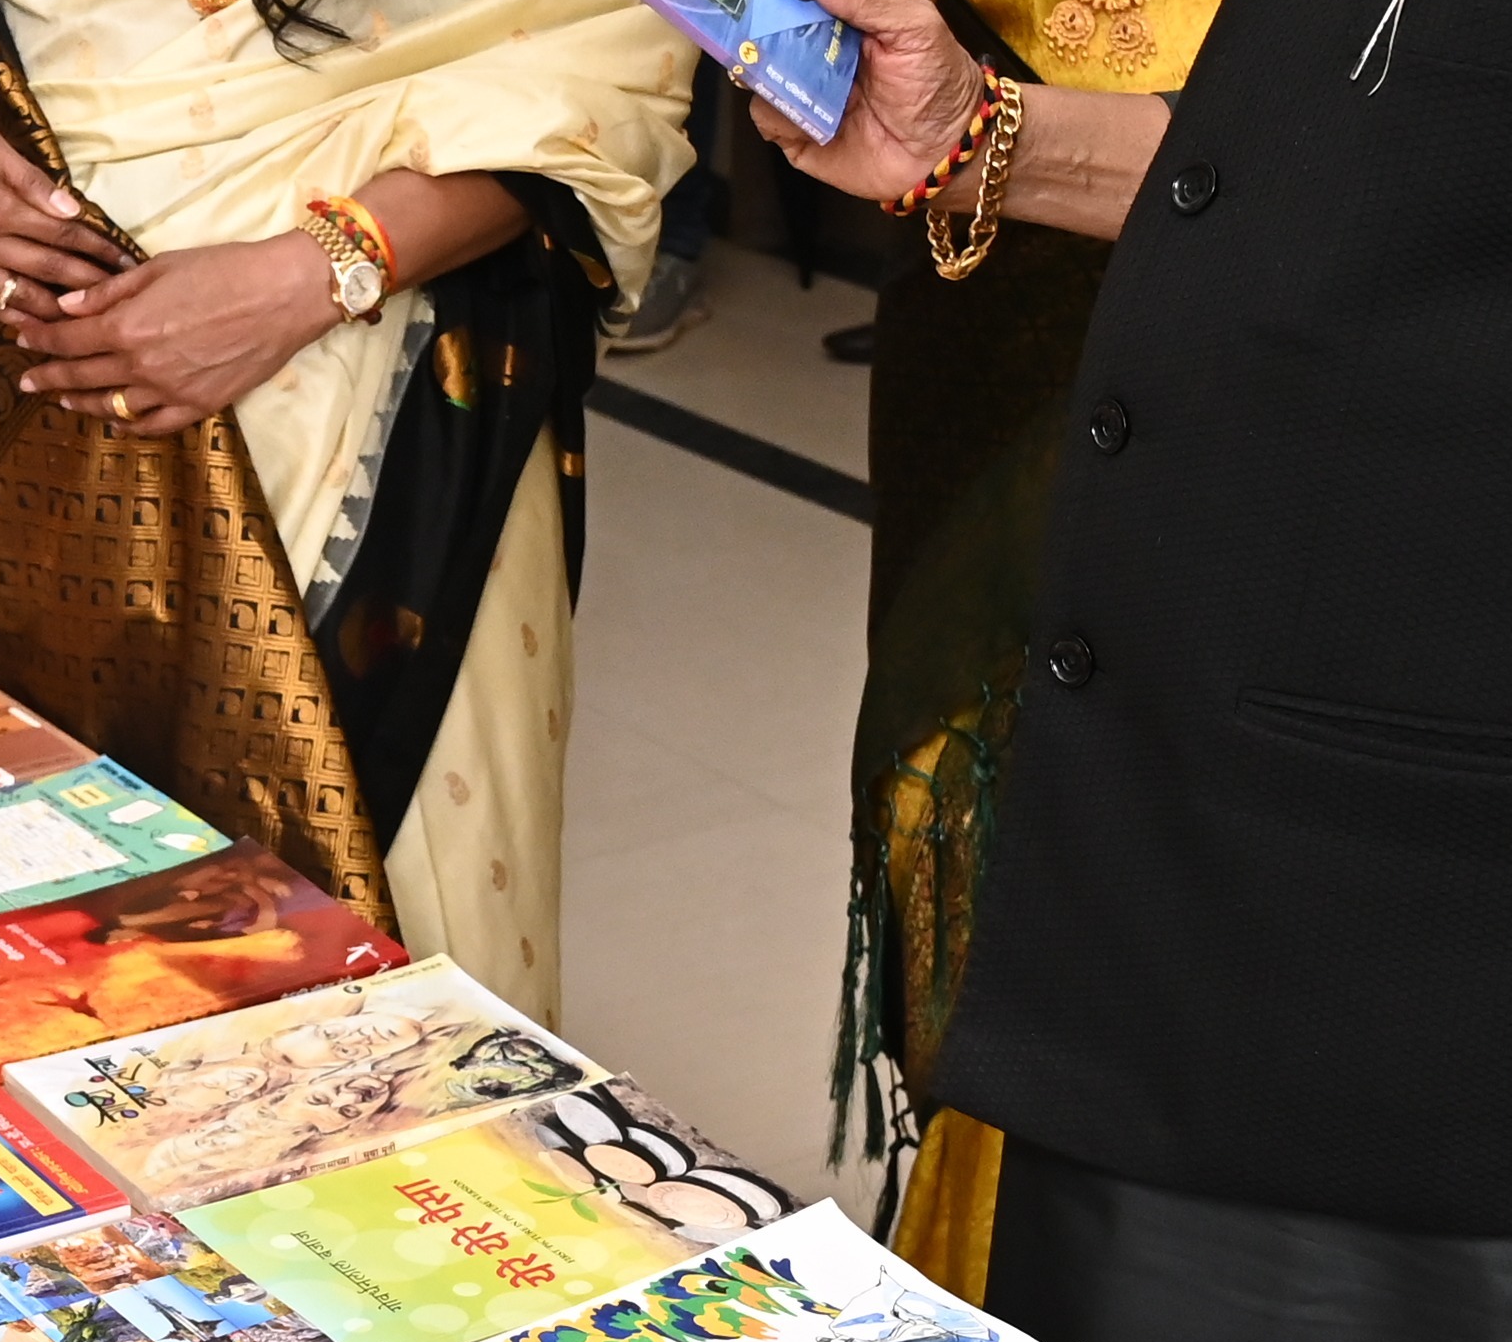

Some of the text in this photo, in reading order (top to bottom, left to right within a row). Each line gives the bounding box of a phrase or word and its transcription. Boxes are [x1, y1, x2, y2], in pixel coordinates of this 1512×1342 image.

[290, 1230, 402, 1313] गोवर्धनलाल बजाज
[393, 1179, 556, 1288] येरे येरे पैसा
